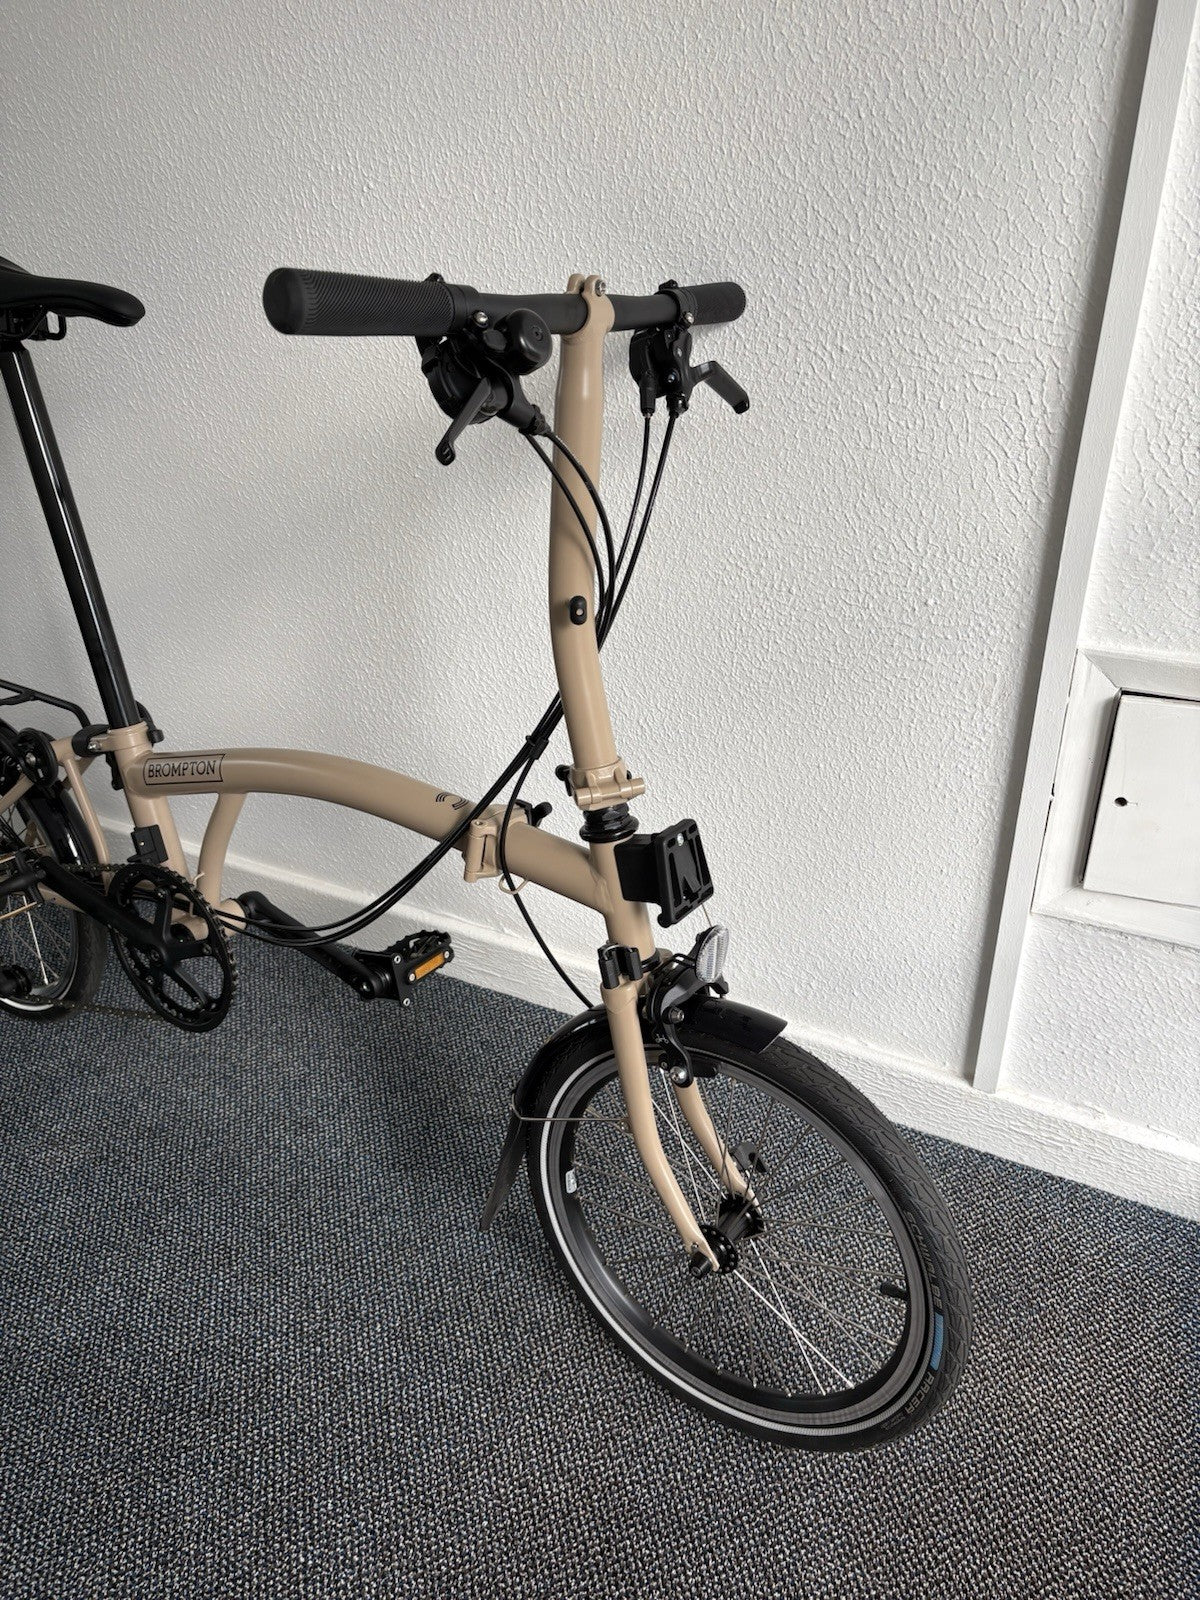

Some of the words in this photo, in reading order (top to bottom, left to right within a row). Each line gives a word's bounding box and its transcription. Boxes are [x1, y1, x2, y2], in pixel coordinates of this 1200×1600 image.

[148, 760, 216, 778] BROMPTON
[904, 1210, 943, 1310] SCHWALBE
[905, 1371, 935, 1414] RACER
